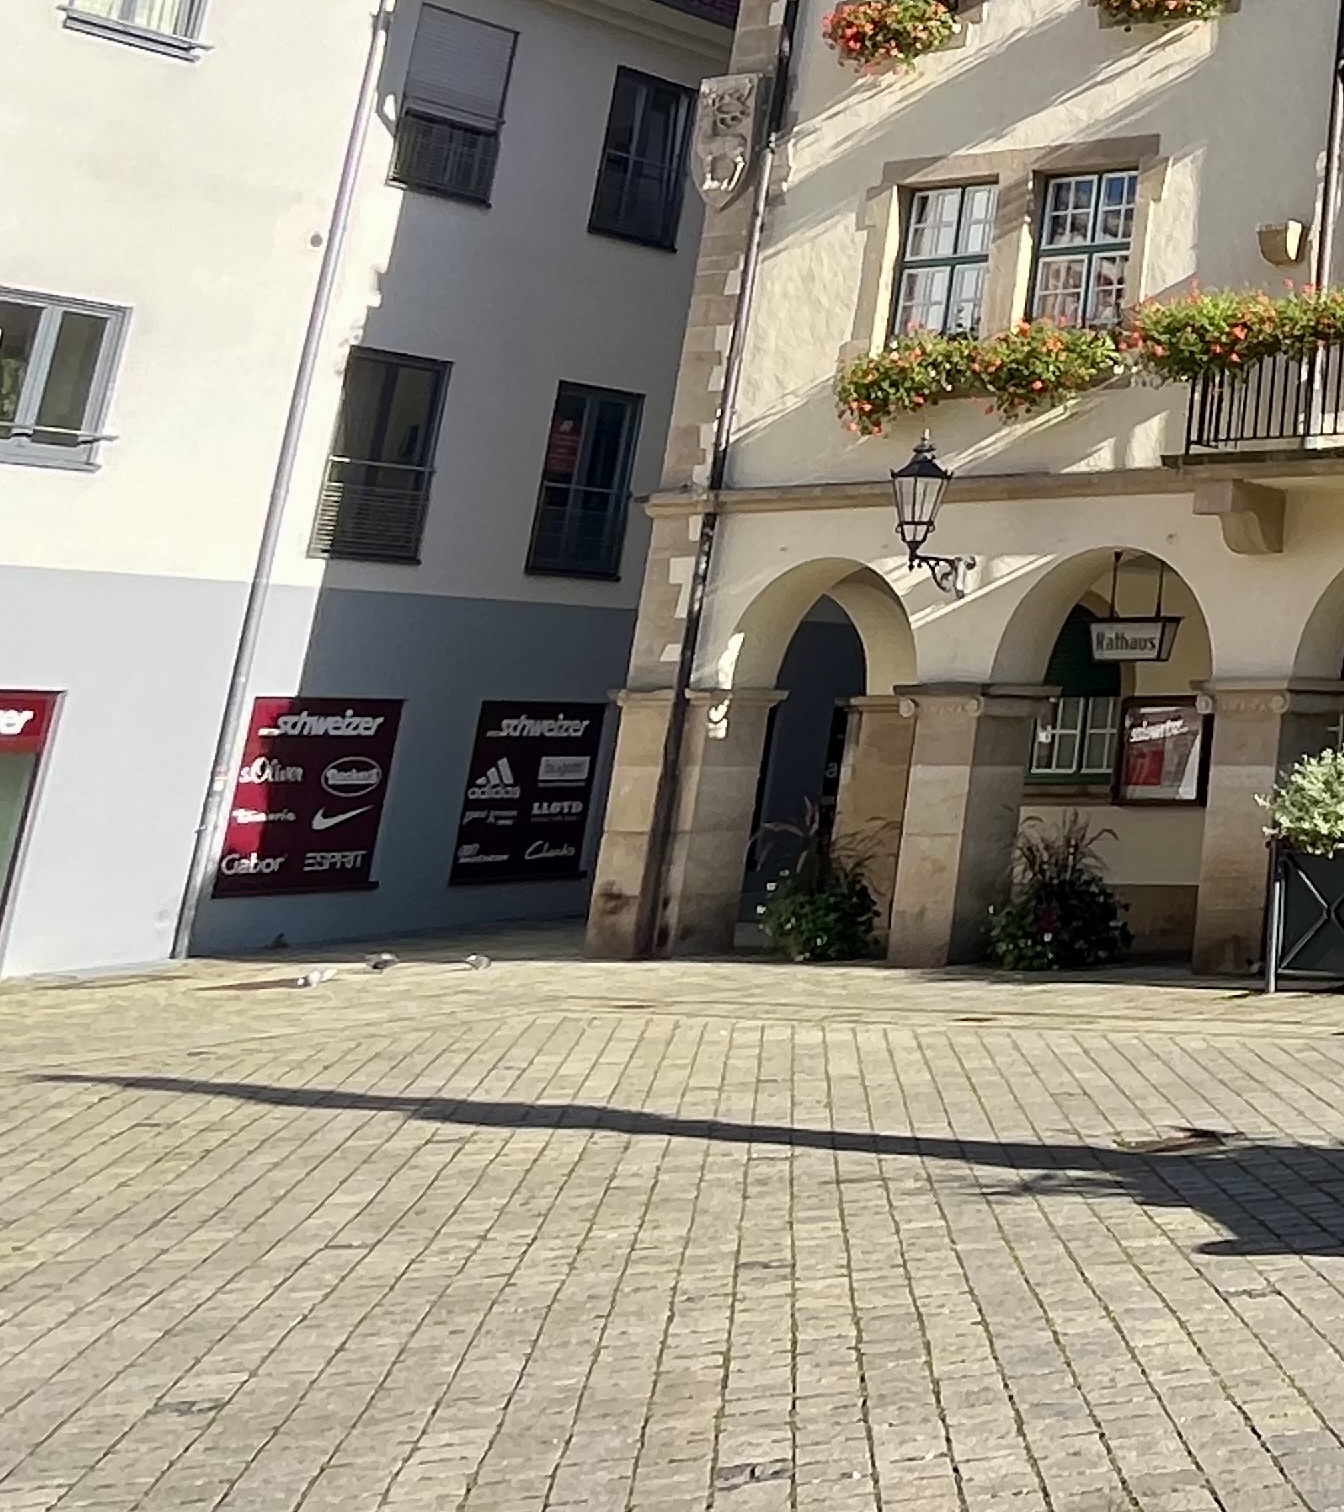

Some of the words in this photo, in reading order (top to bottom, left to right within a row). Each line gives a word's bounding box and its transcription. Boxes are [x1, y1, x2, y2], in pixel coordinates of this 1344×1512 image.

[1096, 631, 1157, 652] Rathaus
[276, 709, 386, 736] schweizer
[500, 713, 591, 737] schweizer
[220, 851, 288, 876] Gabor
[302, 850, 368, 872] ESPRIT
